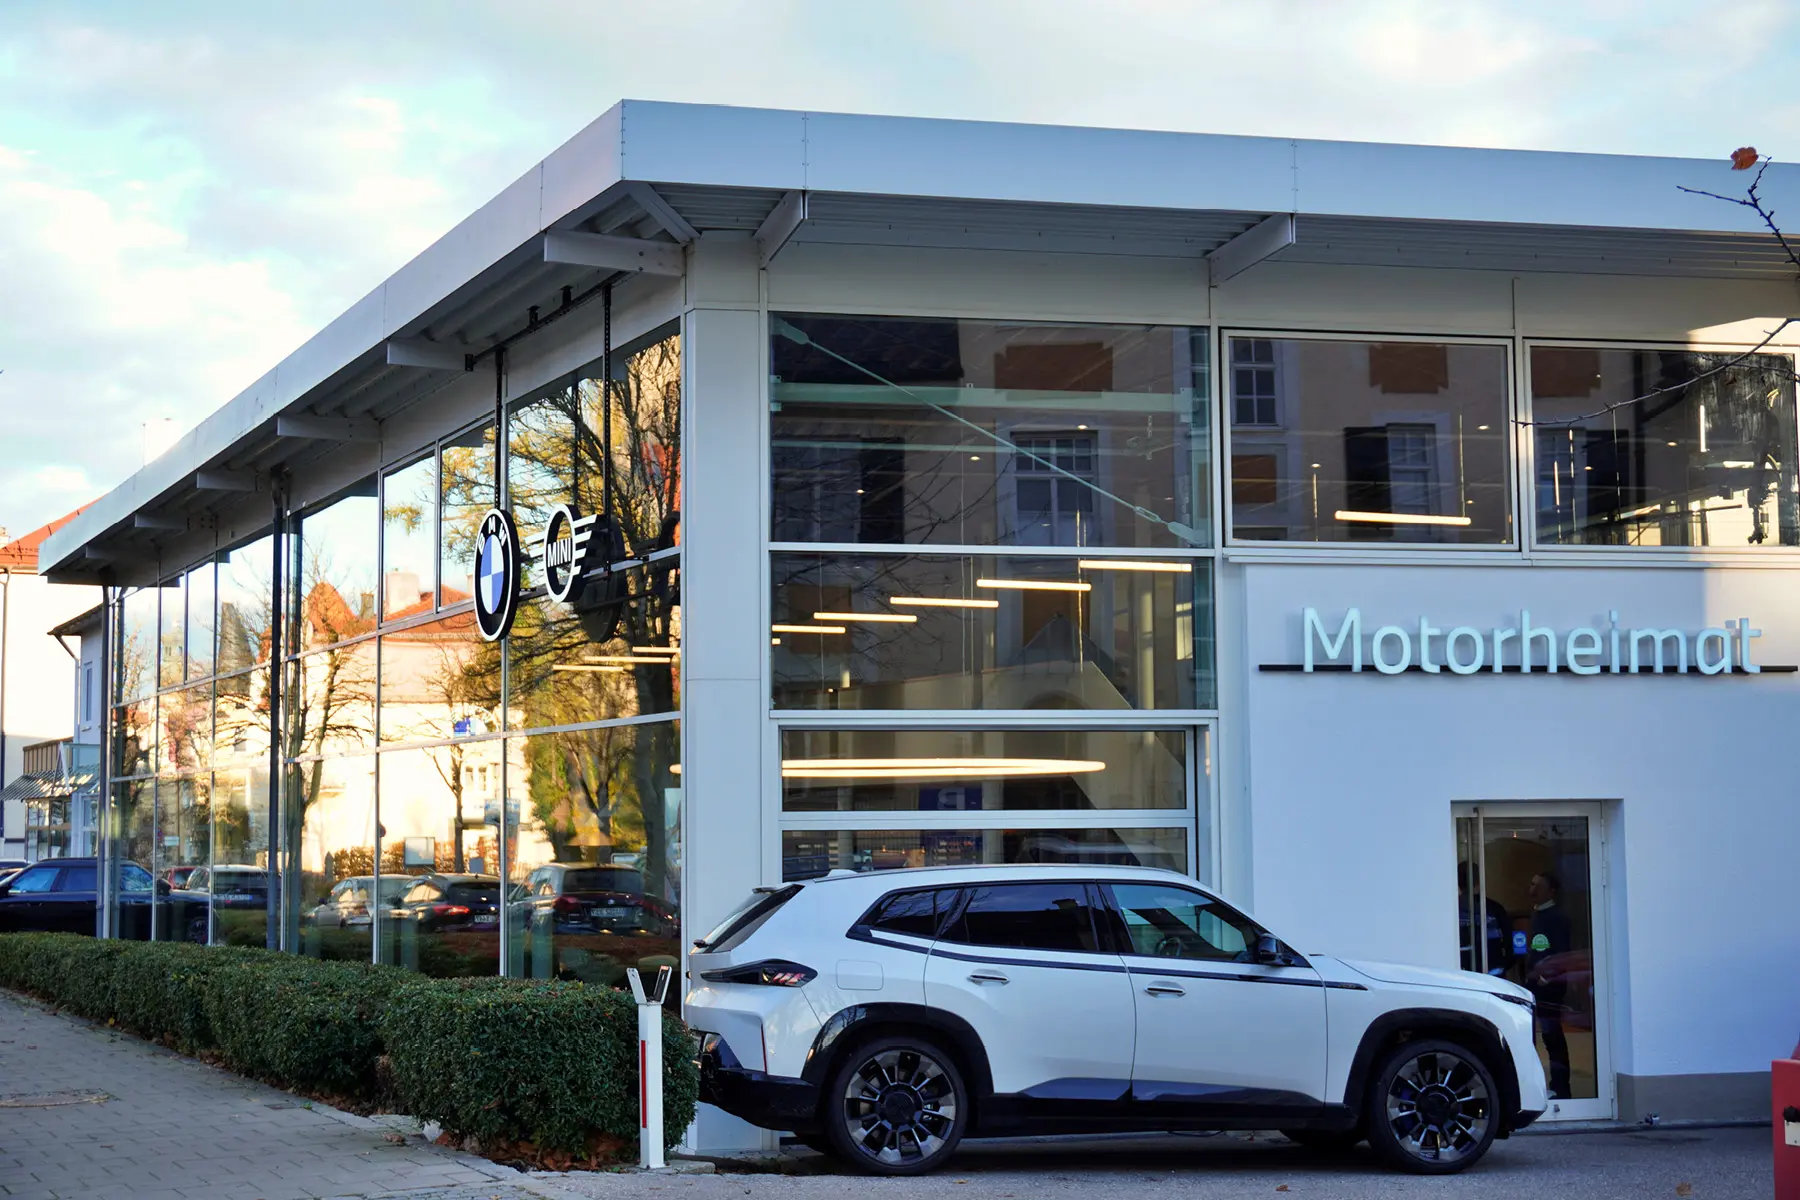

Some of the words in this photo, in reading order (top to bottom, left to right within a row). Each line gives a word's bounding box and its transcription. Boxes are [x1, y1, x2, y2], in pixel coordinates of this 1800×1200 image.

[478, 515, 507, 555] BMW
[547, 537, 572, 568] MINI
[1302, 607, 1761, 675] Motorheimat
